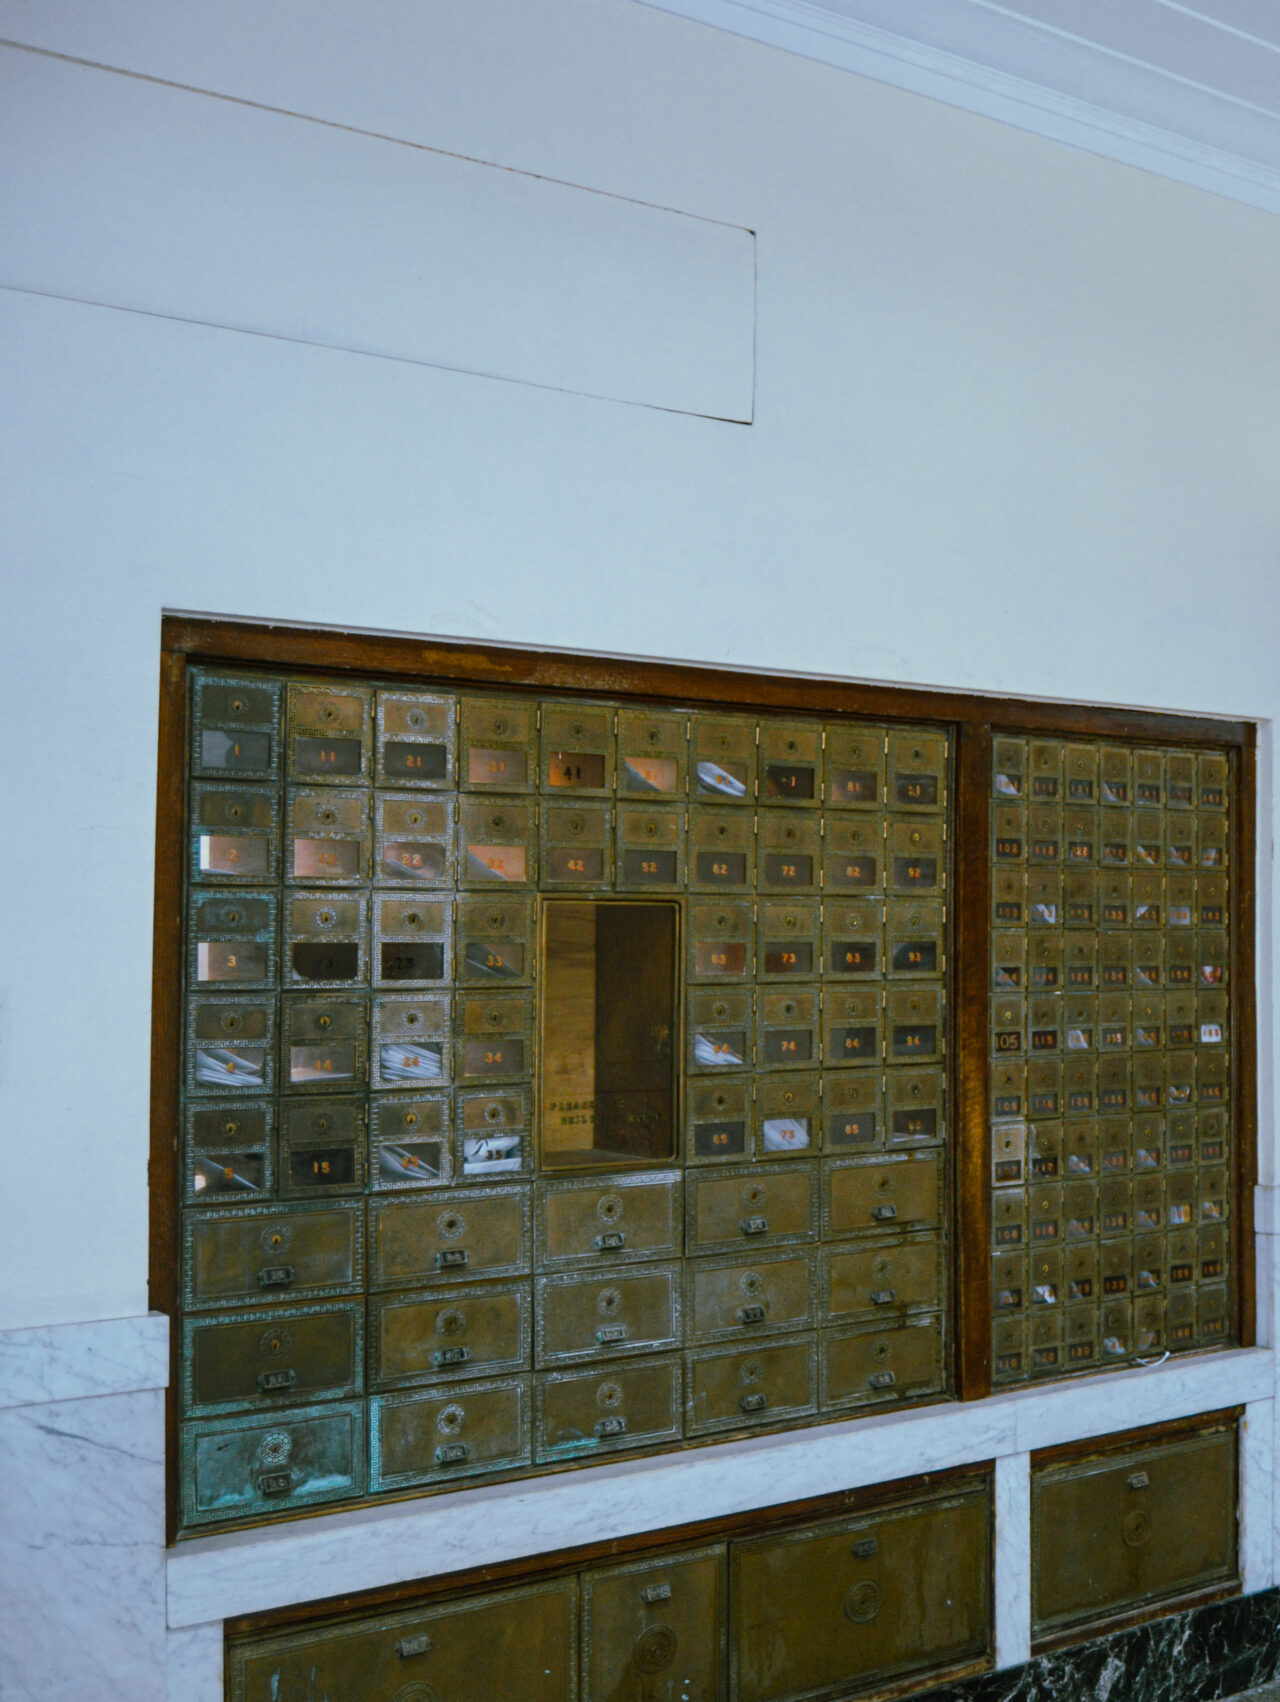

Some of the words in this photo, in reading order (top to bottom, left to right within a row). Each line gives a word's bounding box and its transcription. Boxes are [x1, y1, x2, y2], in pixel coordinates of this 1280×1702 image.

[319, 750, 336, 763] 11
[405, 755, 423, 768] 21
[563, 766, 580, 780] 41
[228, 849, 239, 863] 2
[401, 853, 422, 868] 22
[567, 859, 583, 872] 42
[641, 861, 657, 872] 52
[712, 863, 728, 875] 62
[782, 865, 795, 877] 72
[226, 955, 236, 968] 3
[485, 955, 503, 968] 33
[782, 952, 796, 965] 73
[781, 1040, 796, 1052] 74
[906, 1034, 920, 1046] 94
[995, 1035, 1019, 1049] 105
[403, 1056, 420, 1068] 24
[485, 1052, 503, 1063] 34
[225, 1060, 235, 1074] 4
[315, 1059, 333, 1072] 14
[781, 1129, 795, 1141] 75
[313, 1161, 330, 1174] 15
[401, 1155, 418, 1169] 25
[224, 1167, 234, 1180] 5
